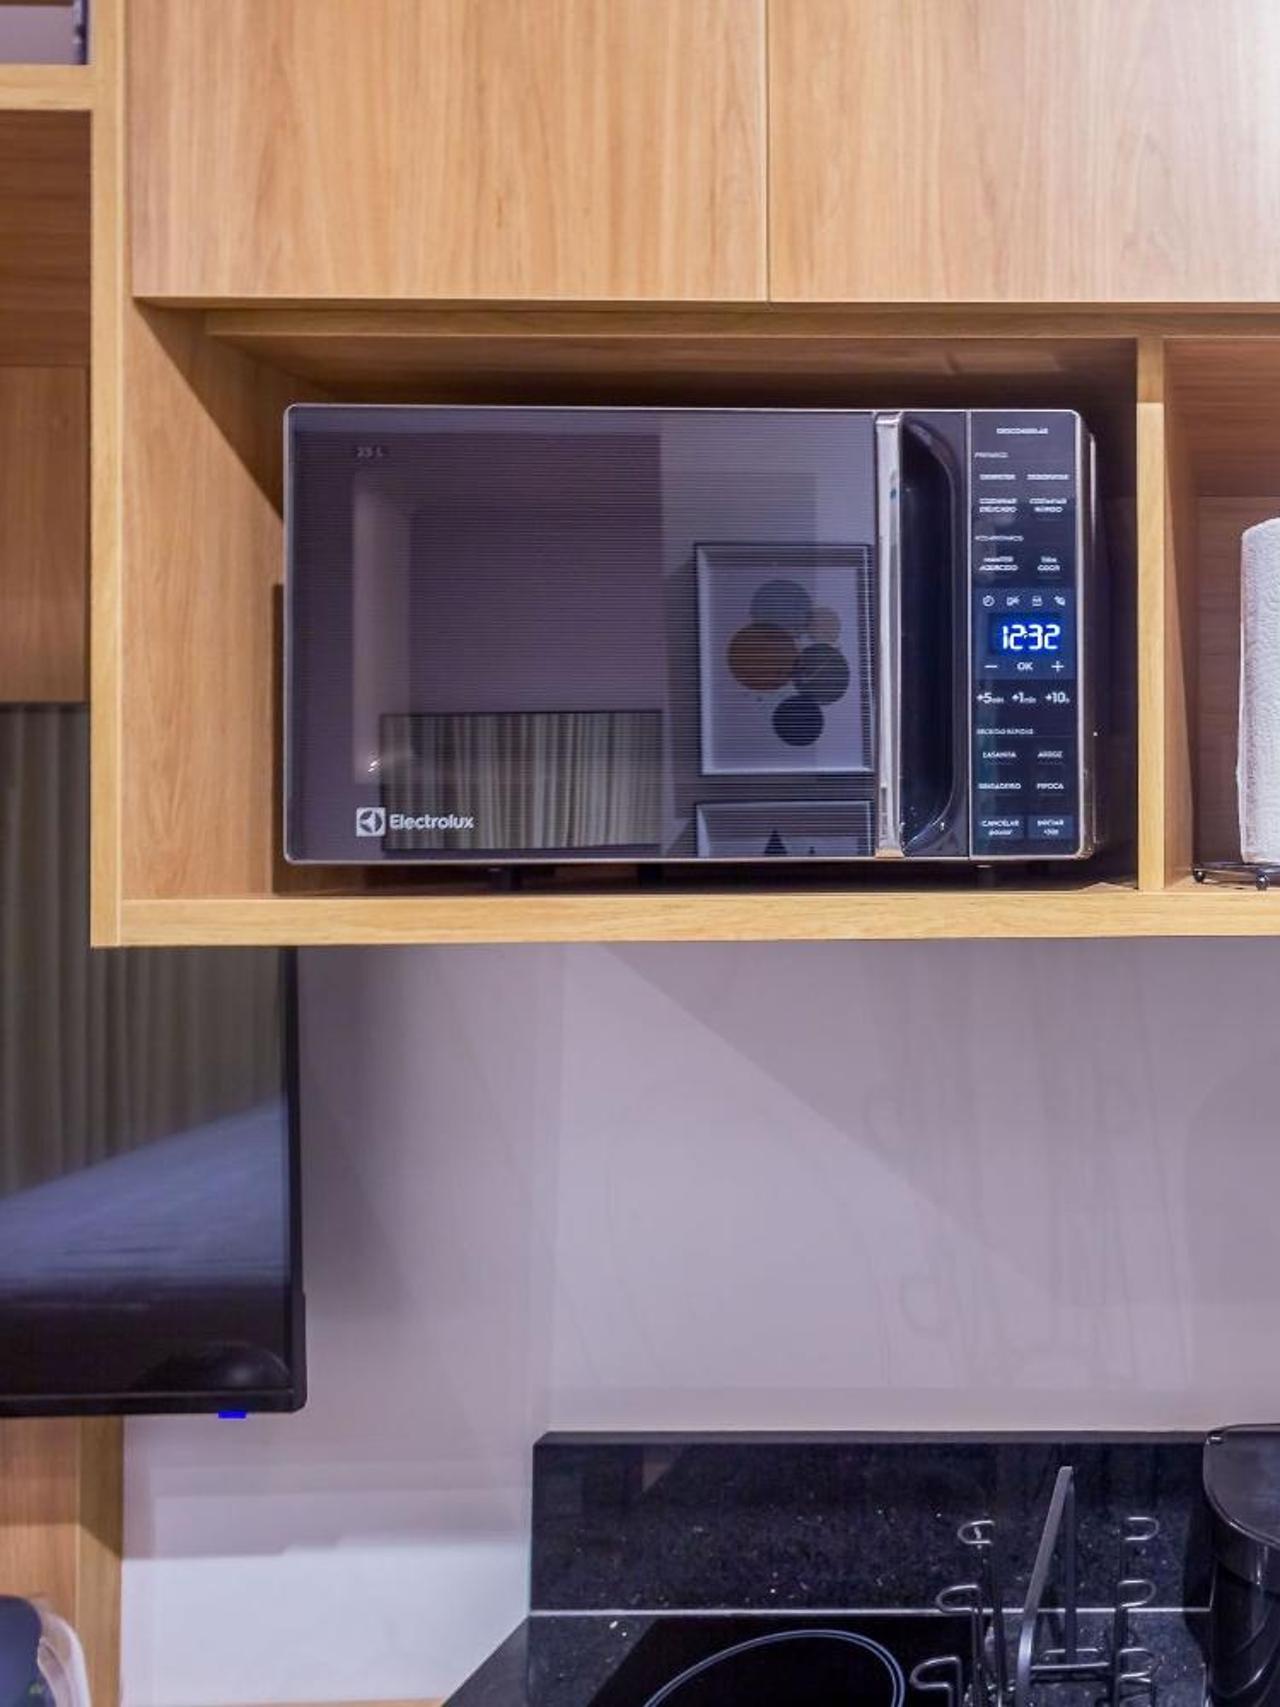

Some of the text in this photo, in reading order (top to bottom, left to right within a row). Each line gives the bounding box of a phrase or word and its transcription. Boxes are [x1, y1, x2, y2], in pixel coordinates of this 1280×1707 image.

[1002, 623, 1061, 650] 12:32
[1017, 661, 1033, 671] OK
[389, 814, 475, 830] Electrolux
